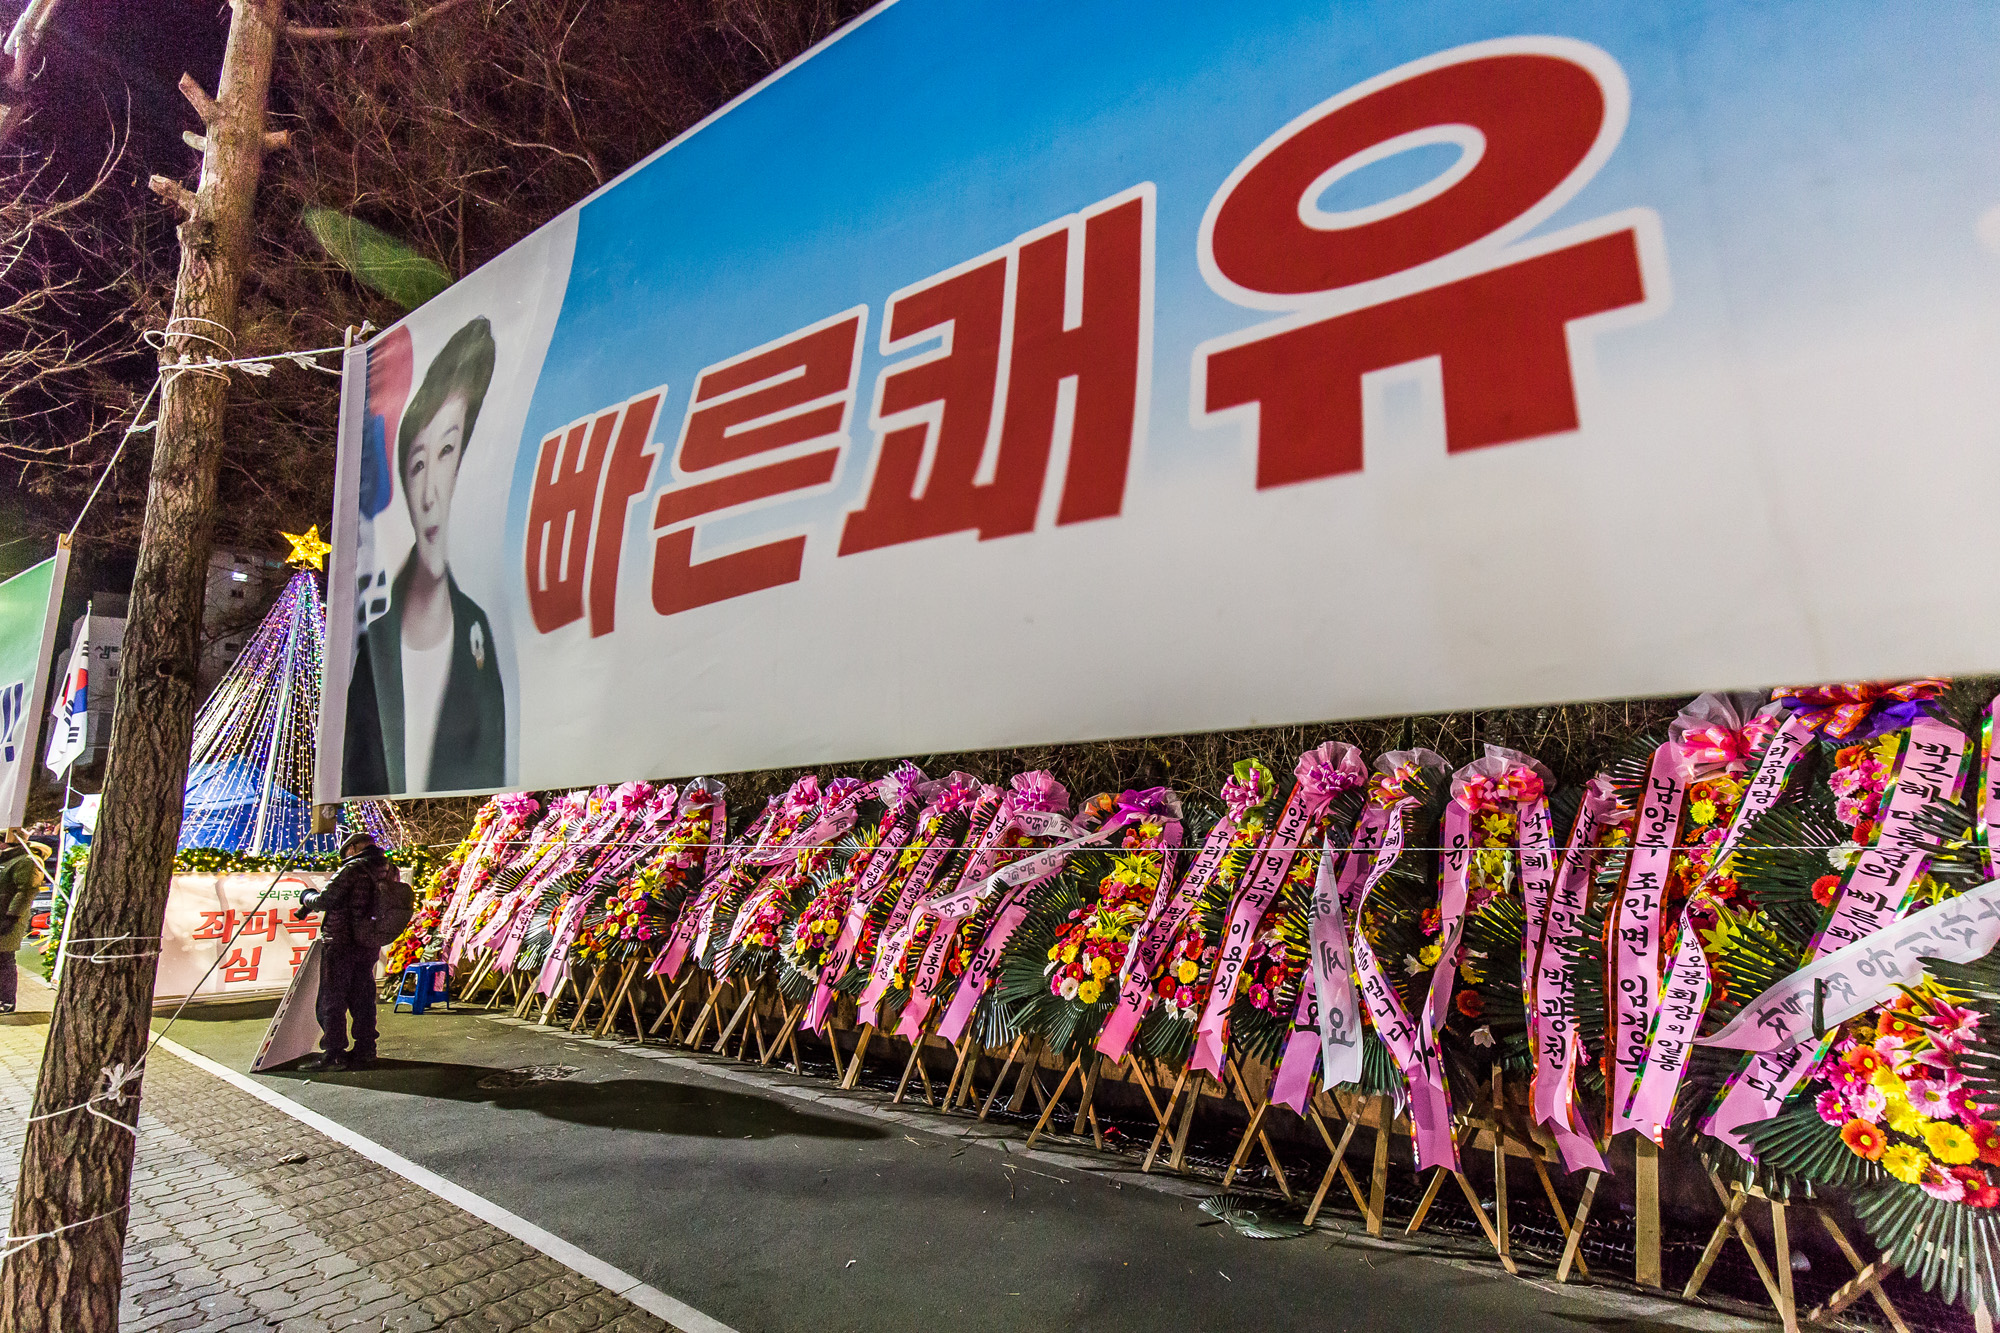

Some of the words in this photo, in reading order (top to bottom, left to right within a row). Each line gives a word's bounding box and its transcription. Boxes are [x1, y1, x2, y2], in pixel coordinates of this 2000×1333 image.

[1752, 732, 1801, 804] 우리공화당
[1898, 742, 1962, 801] 박근혜
[1521, 812, 1547, 870] 박근혜
[1635, 777, 1682, 857] 남양주
[1181, 831, 1228, 902] 우리공화당
[1245, 857, 1282, 908] 덕소리
[1620, 873, 1660, 957] 조안면
[1835, 888, 1892, 931] 빠른
[916, 934, 948, 998] 길홍식
[1214, 920, 1248, 999] 이용식
[1365, 975, 1414, 1042] 빕니다
[1664, 988, 1698, 1020] 회장
[1649, 1040, 1684, 1071] 일동
